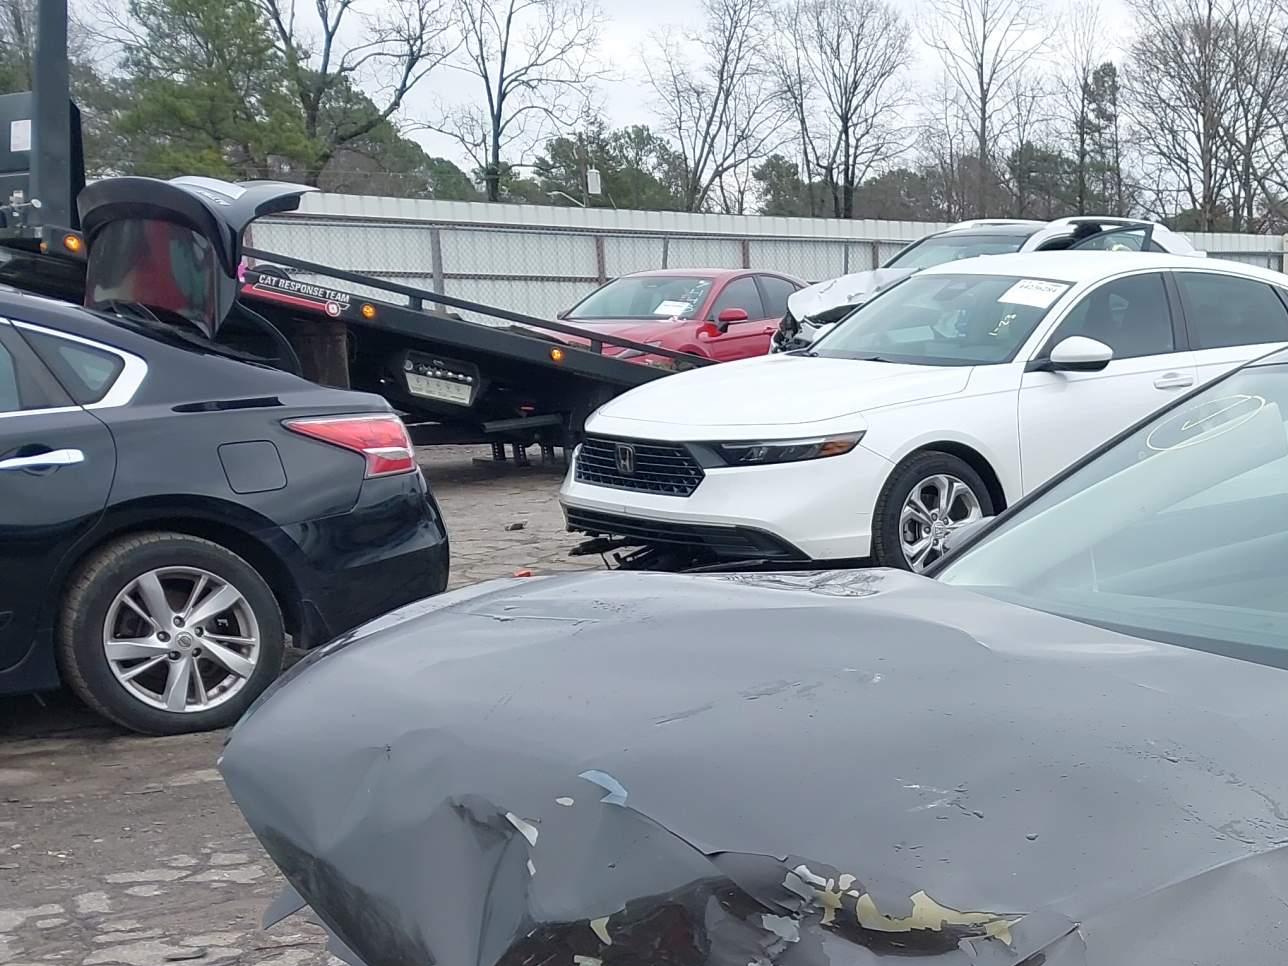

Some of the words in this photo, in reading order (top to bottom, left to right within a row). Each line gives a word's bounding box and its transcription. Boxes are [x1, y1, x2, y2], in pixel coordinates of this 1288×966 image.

[259, 274, 277, 286] CAT
[279, 279, 324, 298] RESPONSE
[325, 290, 351, 303] TEAM
